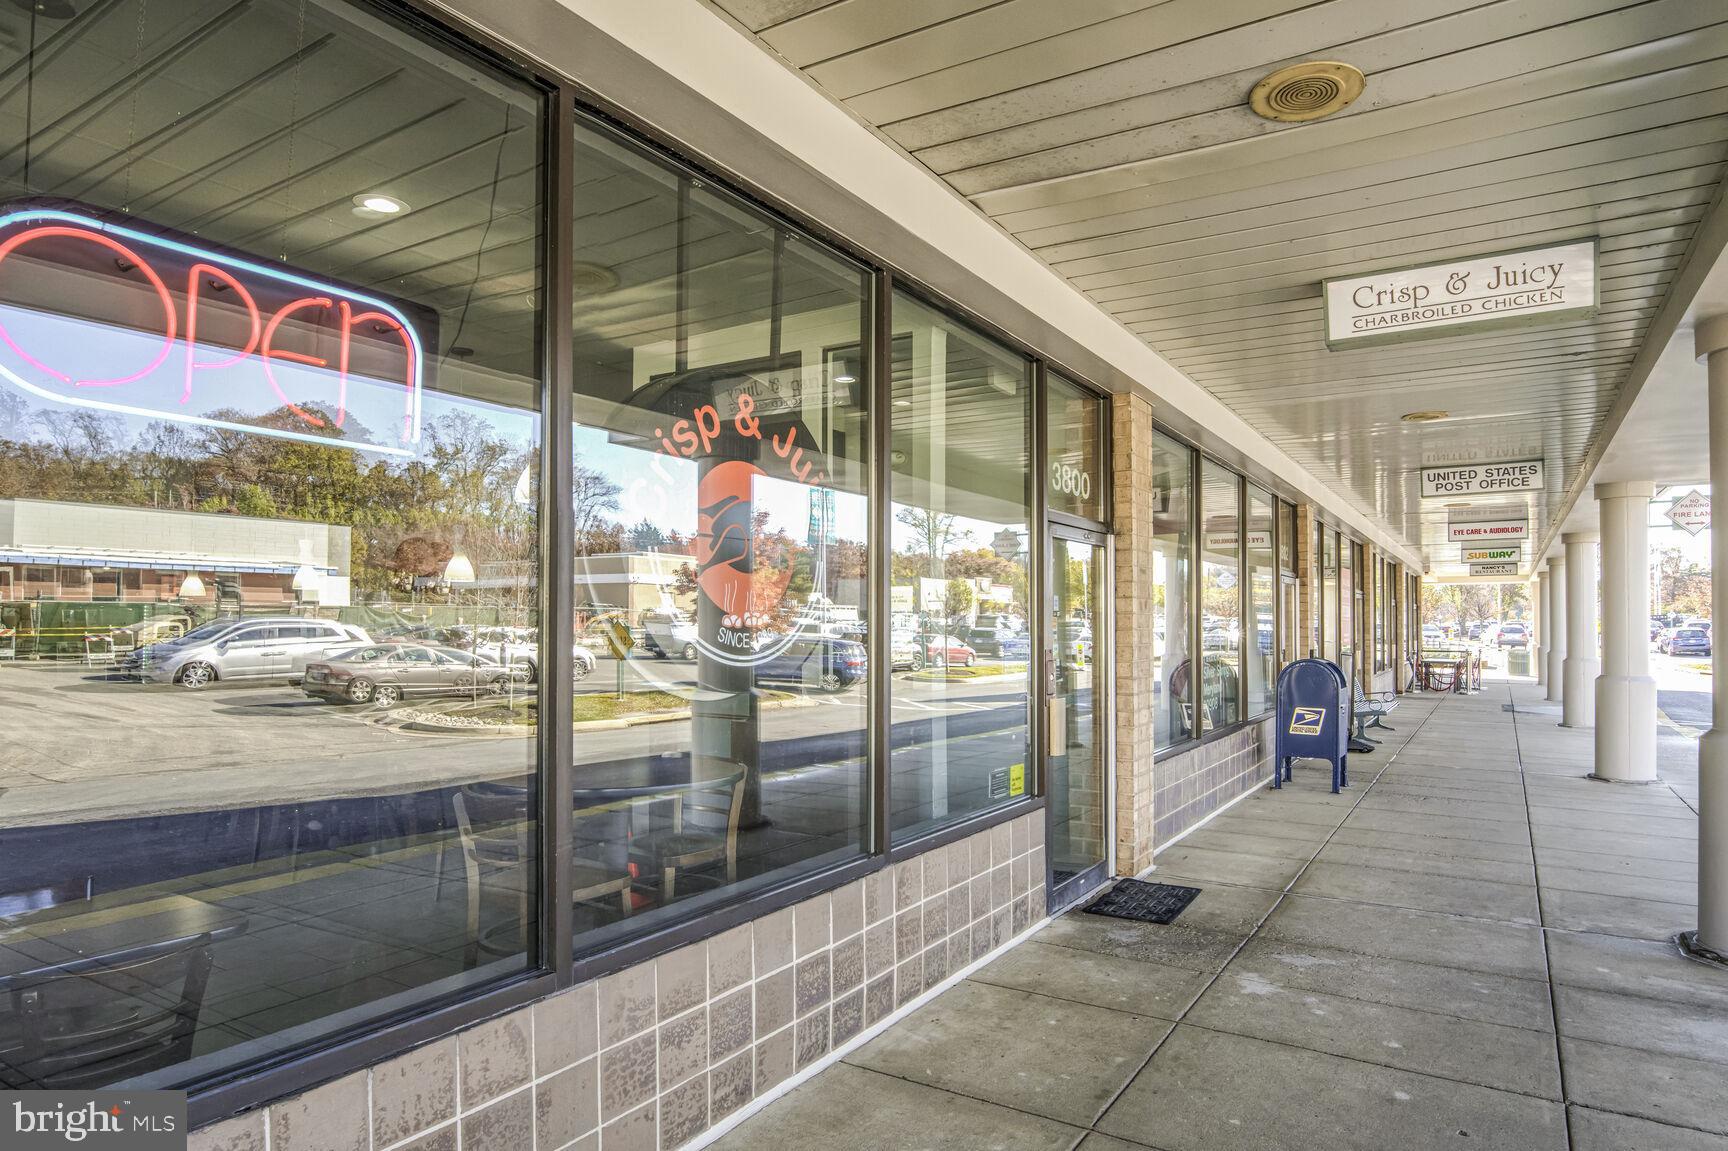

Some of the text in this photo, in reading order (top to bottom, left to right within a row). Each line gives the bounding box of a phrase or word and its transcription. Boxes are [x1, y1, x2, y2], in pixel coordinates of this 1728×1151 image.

[1352, 262, 1565, 309] Crisp & Juicy
[1353, 289, 1564, 329] CHARBROILED CHICKEN
[733, 393, 763, 441] &
[1052, 462, 1090, 499] 3800
[1427, 464, 1538, 482] UNITED STATES
[1435, 477, 1530, 492] POST OFFICE
[1489, 526, 1524, 535] AUDIOLOGY
[1466, 550, 1514, 560] SUBWAY
[717, 627, 750, 648] SINCE
